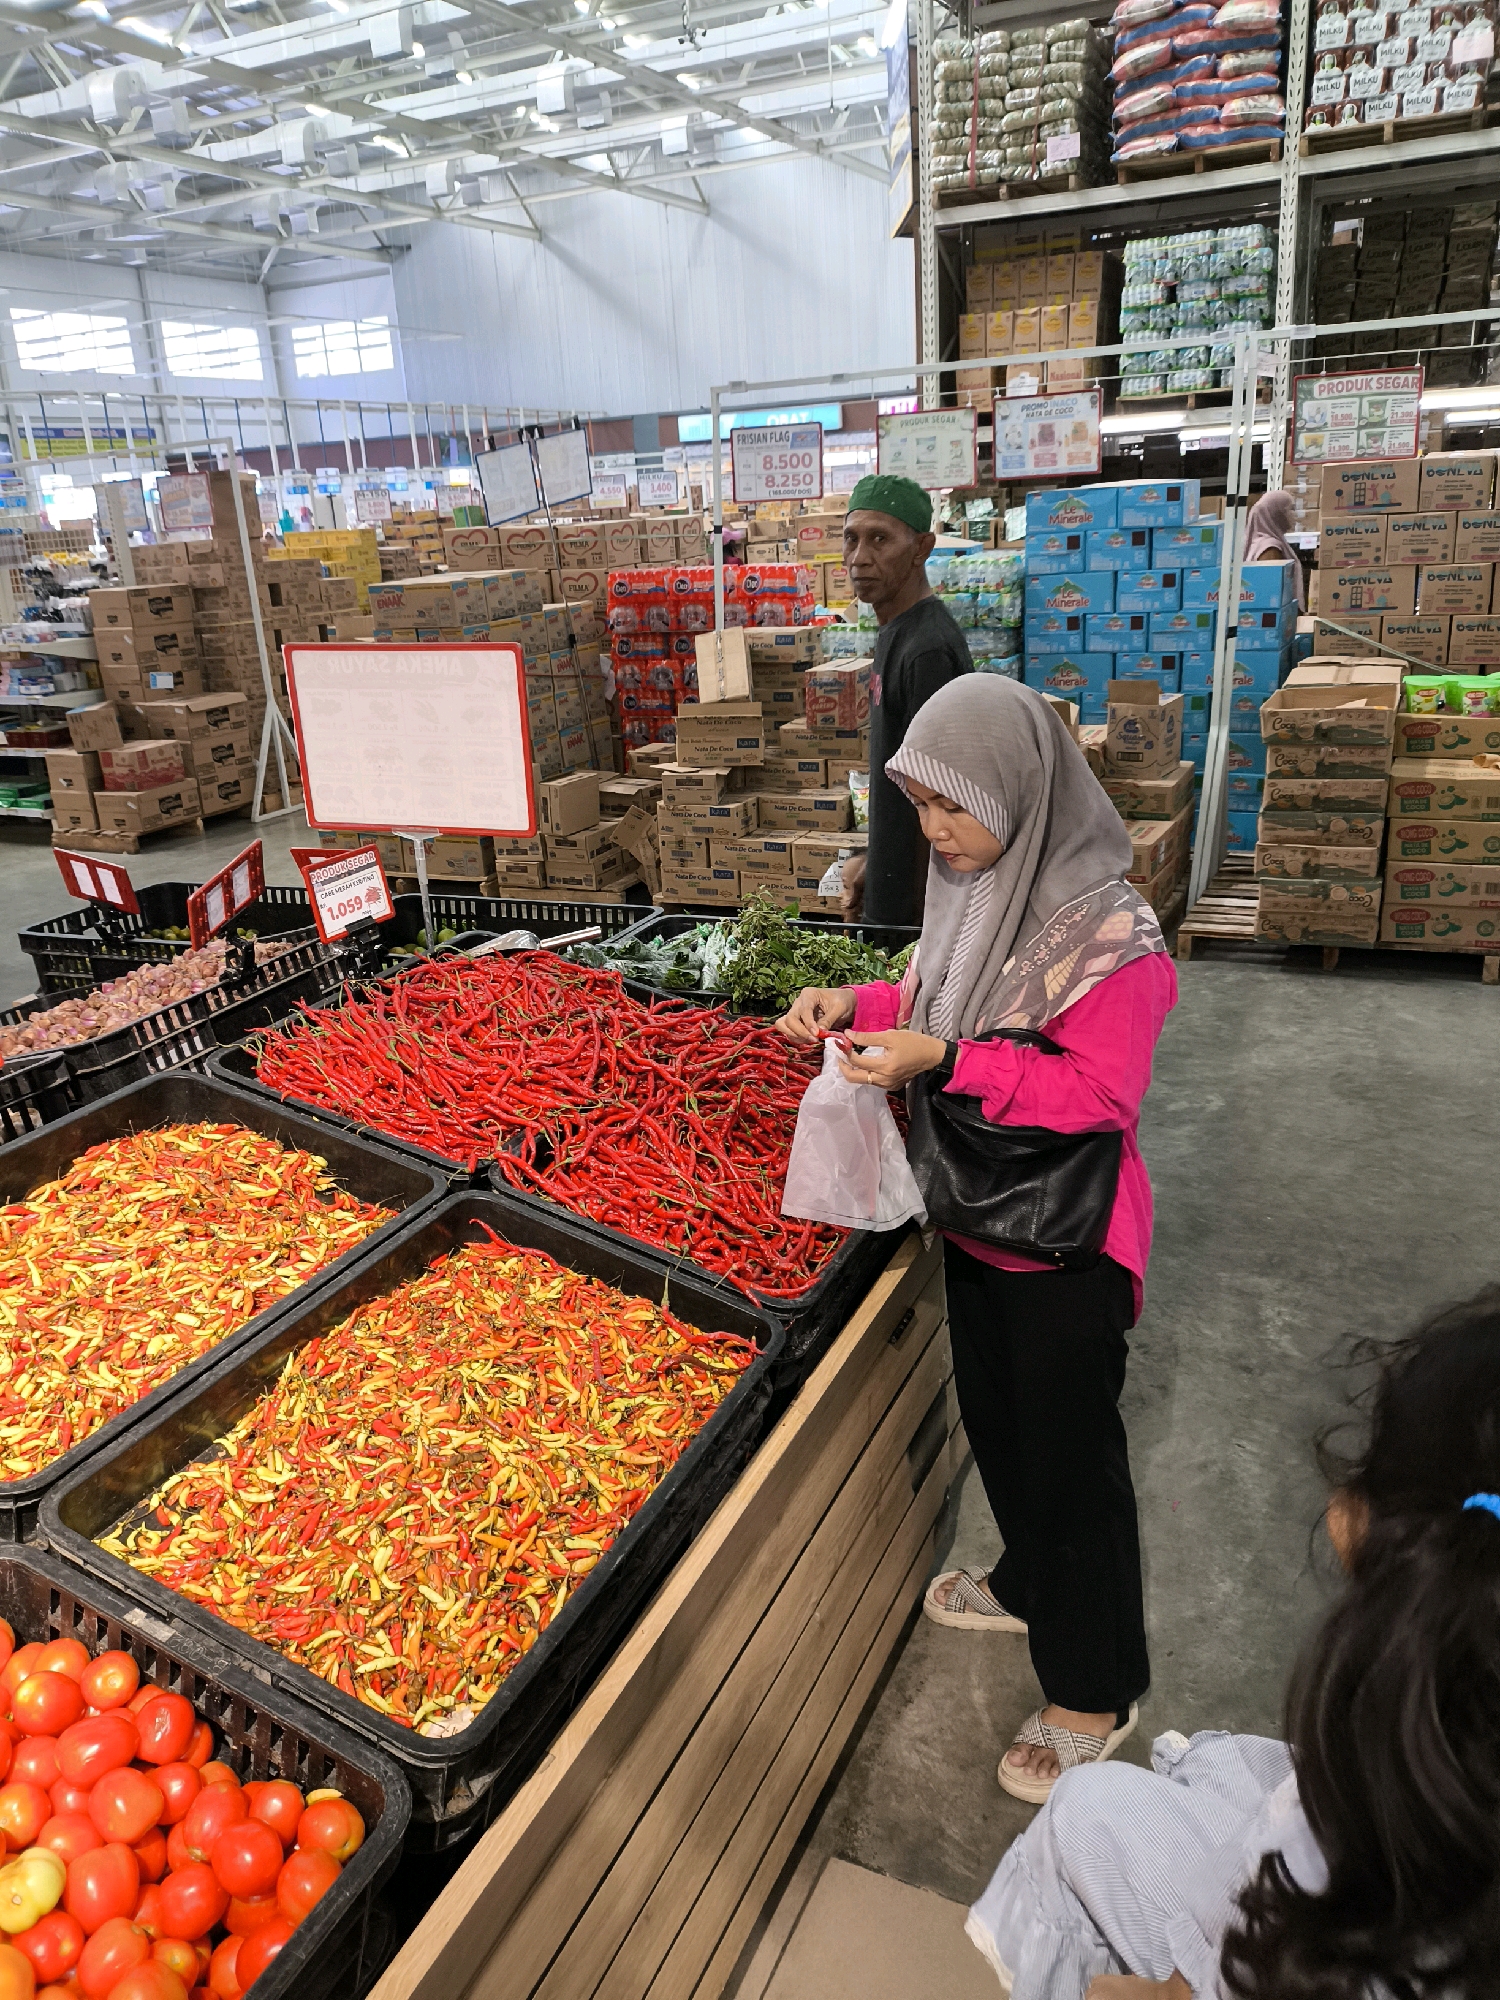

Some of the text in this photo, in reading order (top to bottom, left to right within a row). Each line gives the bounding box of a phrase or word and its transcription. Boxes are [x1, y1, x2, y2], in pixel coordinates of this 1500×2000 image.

[1403, 16, 1429, 26] MILKU
[1319, 28, 1344, 36] MILKU
[1358, 24, 1383, 34] MILKU
[1421, 38, 1446, 48] MILKU
[1380, 47, 1405, 57] MILKU
[1353, 76, 1379, 87] MILKU
[1316, 82, 1341, 93] MILKU
[1446, 88, 1473, 100] MILKU
[1406, 96, 1432, 106] MILKU
[1368, 102, 1394, 113] MILKU
[1318, 376, 1420, 397] PRODUK SEGAR
[1021, 398, 1078, 413] PROMO INACO
[1055, 406, 1074, 415] COCO
[900, 415, 956, 428] PRODUK SEGAR
[736, 431, 790, 445] FRISIAN FLAG
[762, 452, 813, 472] 8.500
[764, 472, 814, 489] 8.250
[1064, 504, 1076, 514] Le
[1048, 512, 1093, 525] Minerale
[568, 584, 590, 592] FILMA
[1061, 588, 1074, 599] Le
[376, 594, 406, 610] ENAAK
[1046, 597, 1090, 608] Minerale
[1060, 667, 1073, 678] Le
[1044, 676, 1089, 687] Minerale
[1272, 717, 1296, 731] Coco
[738, 739, 757, 747] kara
[1275, 753, 1299, 768] Coco
[800, 764, 817, 772] kara
[1270, 788, 1295, 802] Coco
[1399, 784, 1432, 795] WONG COCO
[816, 801, 835, 810] kara
[711, 808, 729, 817] kara
[1401, 827, 1434, 839] WONG COCO
[1262, 853, 1285, 867] Coco
[310, 851, 375, 883] PRODUK SEGAR
[715, 870, 733, 879] kara
[1398, 871, 1432, 882] WONG COCO
[799, 879, 817, 887] kara
[320, 888, 336, 899] CABE
[335, 881, 353, 893] MERAH
[327, 895, 363, 921] 1.059
[1394, 911, 1428, 921] WONG COCO
[1261, 919, 1285, 932] Coco
